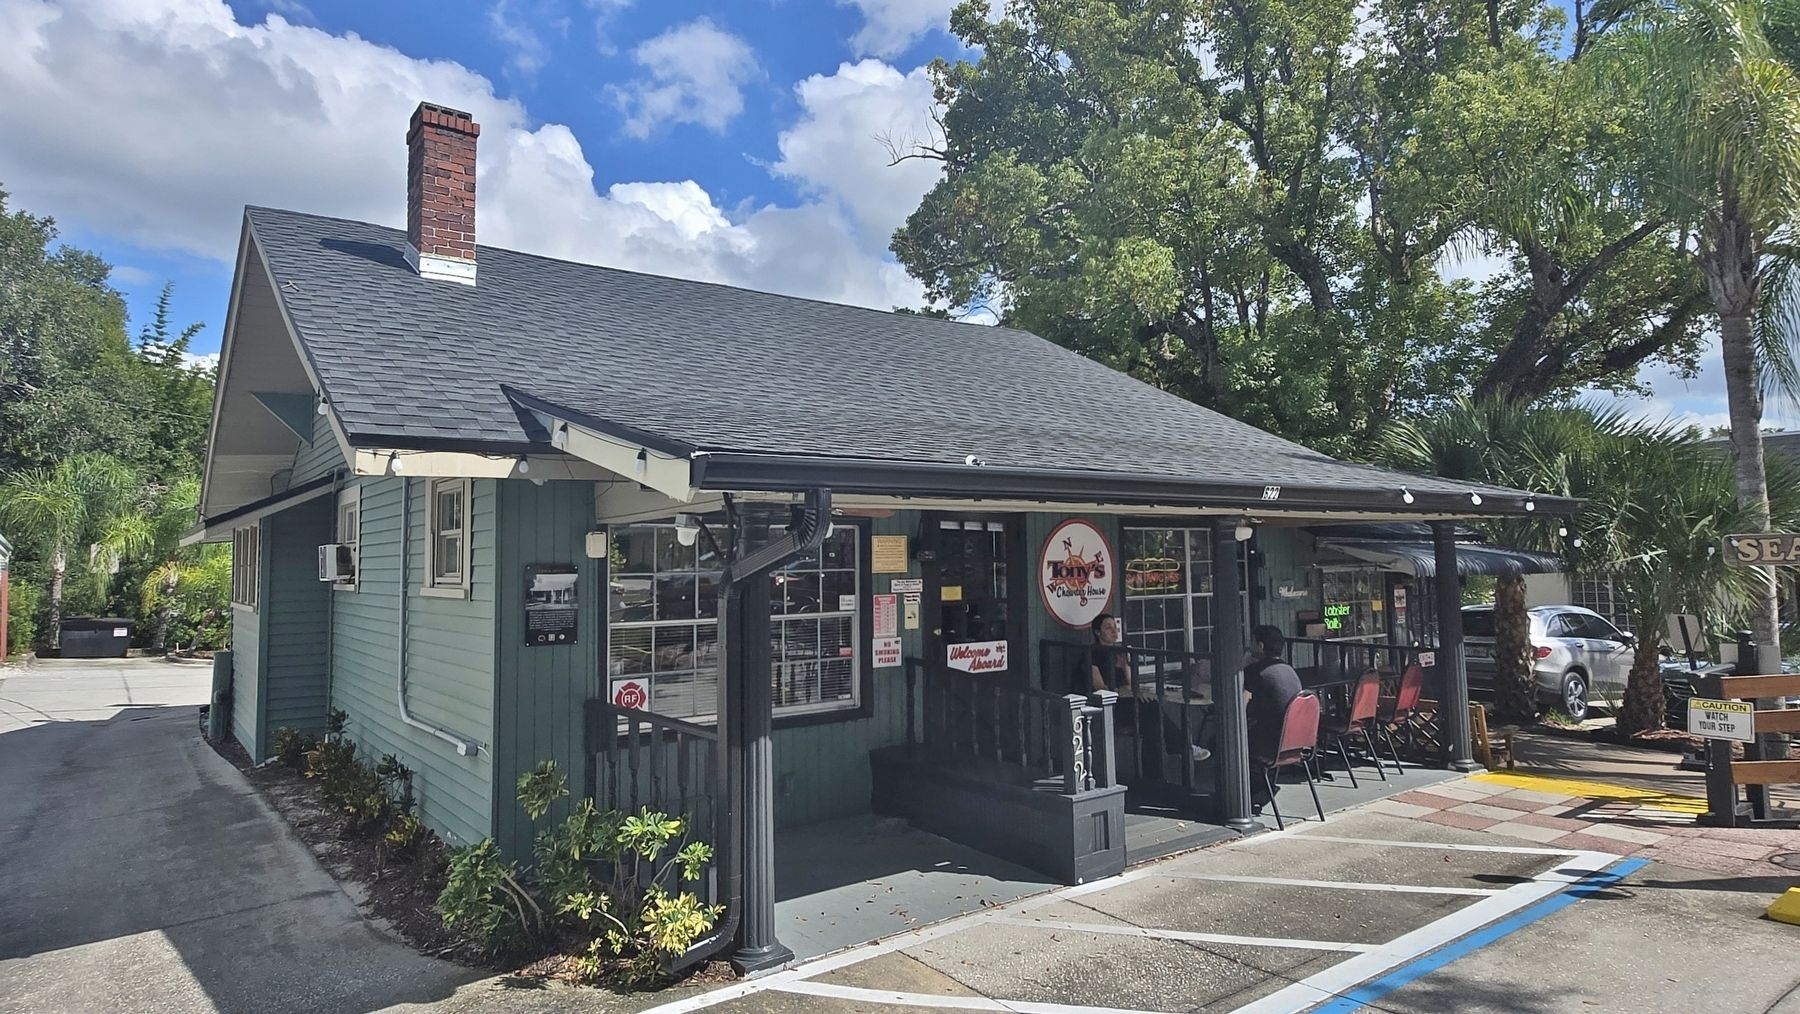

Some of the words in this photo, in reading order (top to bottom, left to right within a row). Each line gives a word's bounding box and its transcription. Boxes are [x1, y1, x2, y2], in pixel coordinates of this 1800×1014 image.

[1062, 537, 1072, 551] N
[1094, 551, 1104, 563] E
[1047, 561, 1105, 581] Tony's
[1046, 582, 1061, 594] W
[1087, 586, 1106, 596] House
[950, 646, 991, 660] Welcome
[968, 655, 1005, 671] Aboard
[624, 694, 637, 703] RF
[1702, 702, 1747, 711] CAUTION
[1705, 711, 1728, 721] WATCH
[1699, 720, 1716, 730] YOUR
[1718, 723, 1735, 732] STEP
[1073, 716, 1087, 781] 622
